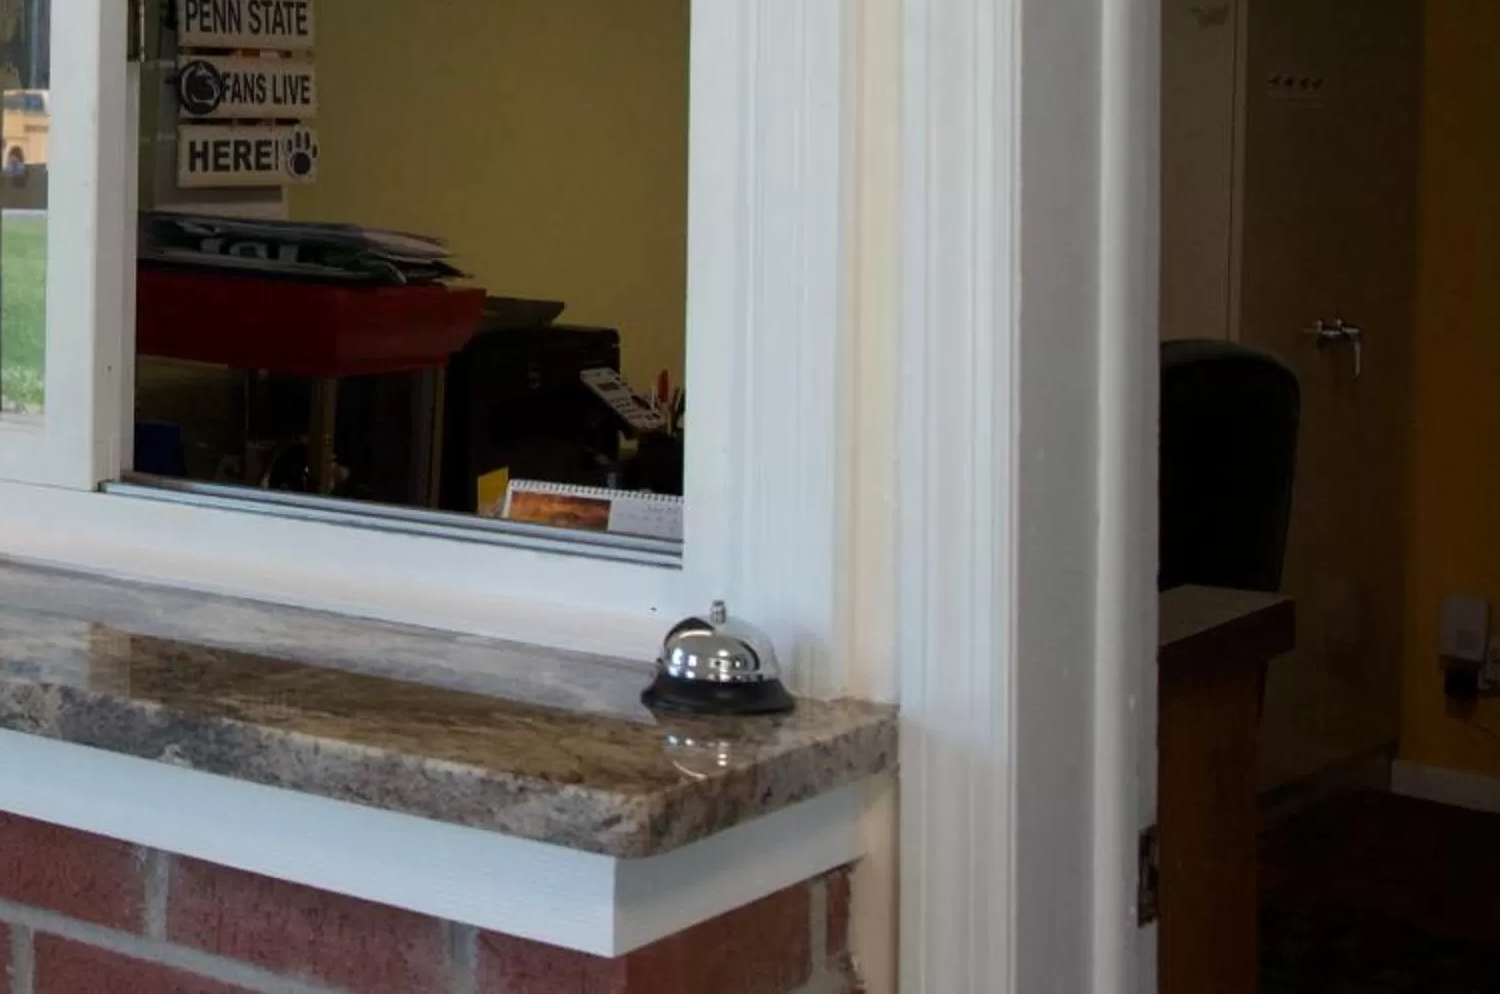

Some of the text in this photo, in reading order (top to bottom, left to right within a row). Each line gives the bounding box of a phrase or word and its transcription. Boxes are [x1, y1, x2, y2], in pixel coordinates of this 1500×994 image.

[248, 0, 308, 36] STATE
[220, 72, 311, 105] FANS LIVE
[188, 139, 279, 172] HERE!
